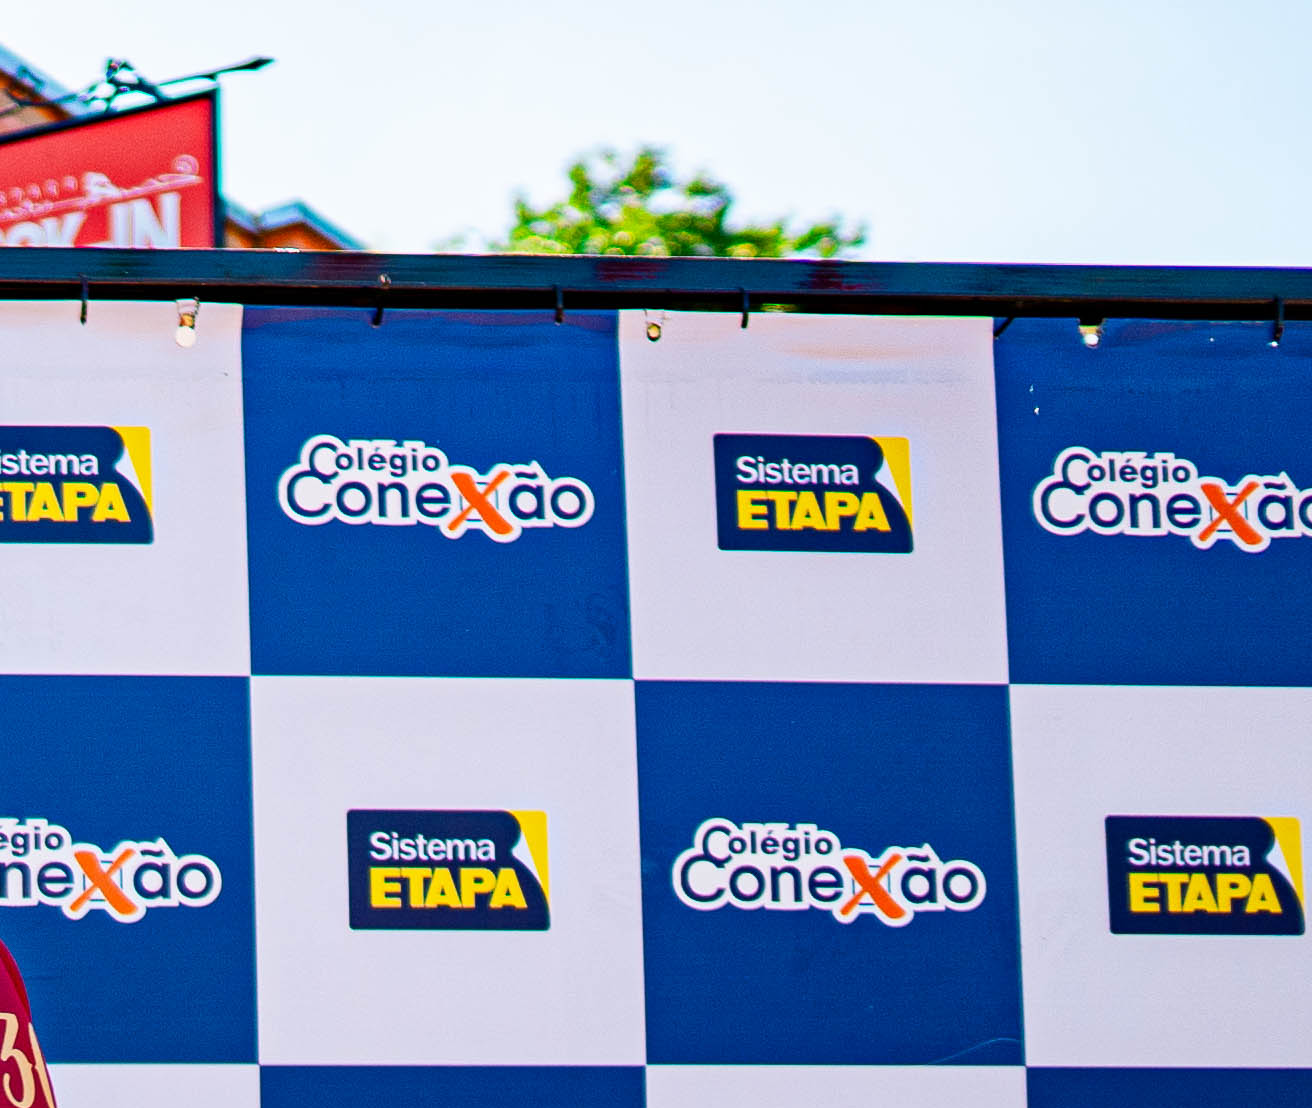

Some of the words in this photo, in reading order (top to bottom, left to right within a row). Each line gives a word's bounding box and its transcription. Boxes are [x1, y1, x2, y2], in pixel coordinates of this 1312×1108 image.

[310, 442, 442, 480] Colégio
[736, 455, 859, 485] Sistema
[1062, 453, 1191, 490] Colégio
[736, 490, 892, 532] ETAPA
[370, 831, 496, 861] Sistema
[703, 825, 834, 862] Colégio
[1128, 837, 1251, 866] Sistema
[369, 867, 527, 909] ETAPA
[1128, 872, 1282, 914] ETAPA
